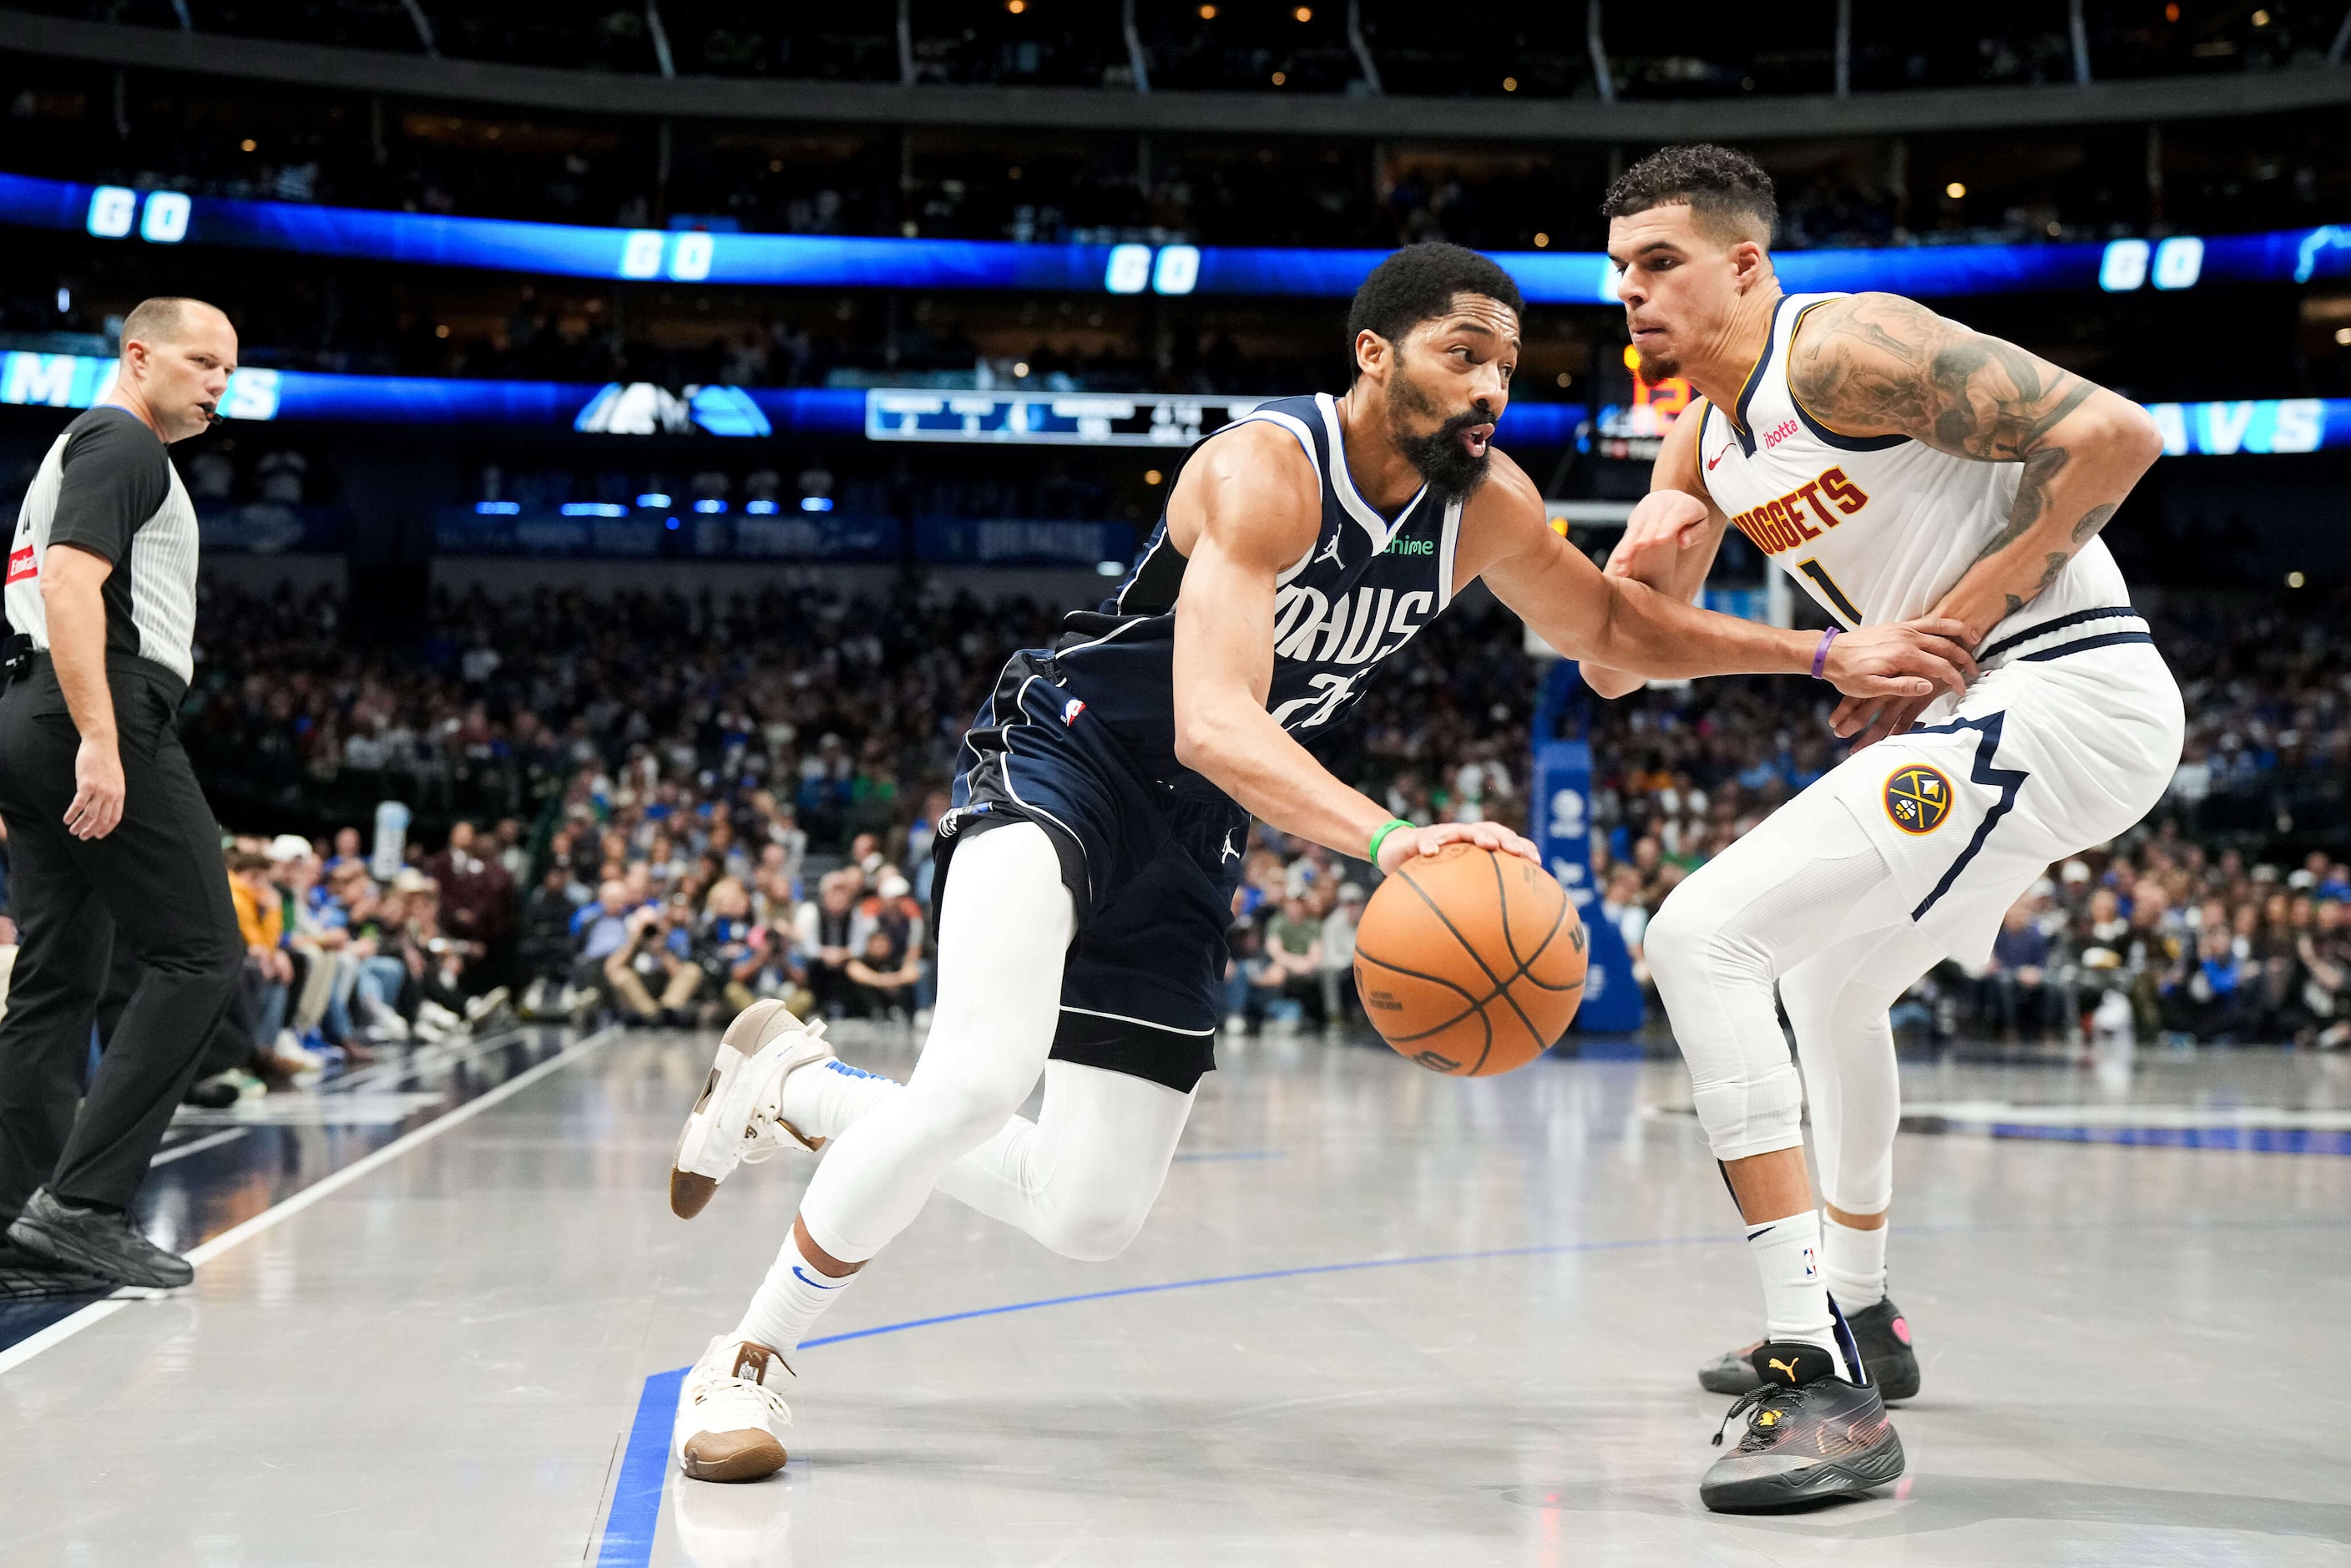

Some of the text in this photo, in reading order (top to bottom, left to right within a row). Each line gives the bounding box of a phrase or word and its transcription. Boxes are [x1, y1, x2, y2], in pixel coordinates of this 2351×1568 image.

[88, 186, 191, 242] GO
[619, 229, 715, 281] GO
[1106, 244, 1201, 294] GO
[2101, 237, 2204, 291] GO
[5, 352, 279, 420] MS
[1763, 419, 1798, 449] ibotta
[1732, 465, 1869, 554] NUGGETS
[1797, 557, 1863, 626] 1
